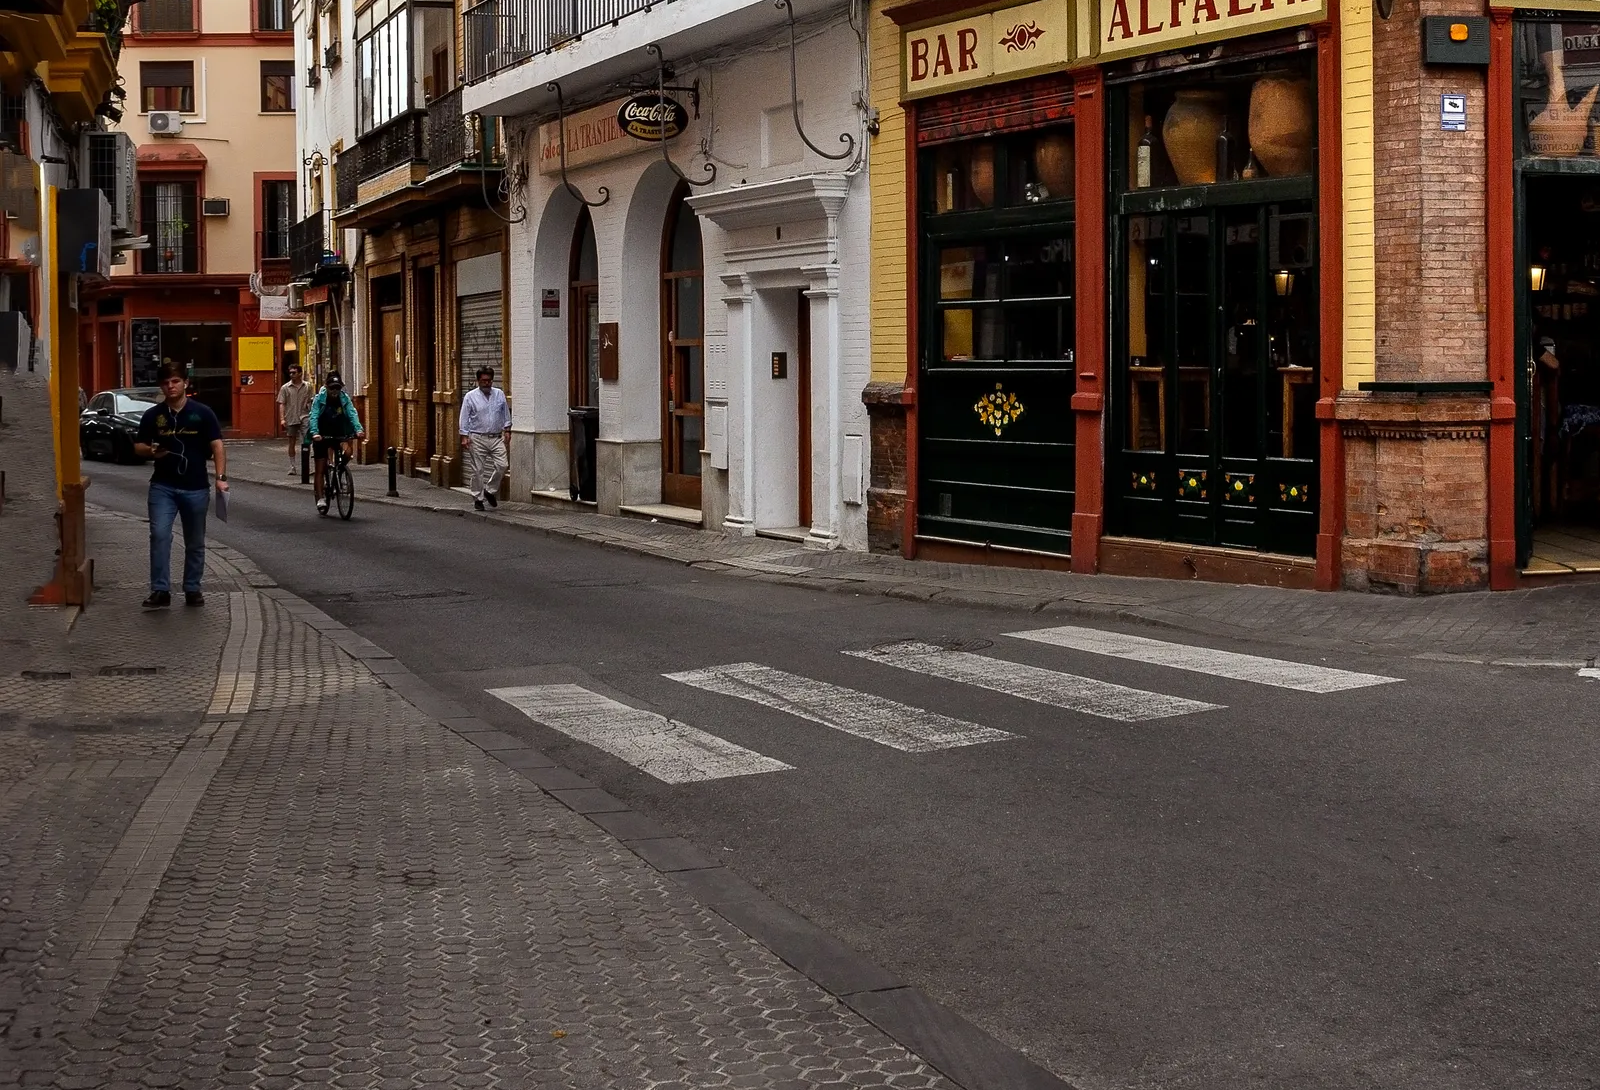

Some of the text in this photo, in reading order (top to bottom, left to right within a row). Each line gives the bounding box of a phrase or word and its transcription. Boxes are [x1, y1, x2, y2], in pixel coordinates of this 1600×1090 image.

[910, 28, 978, 82] BAR
[568, 128, 579, 152] LA
[580, 116, 627, 150] TRASTIEN
[630, 124, 638, 133] LA
